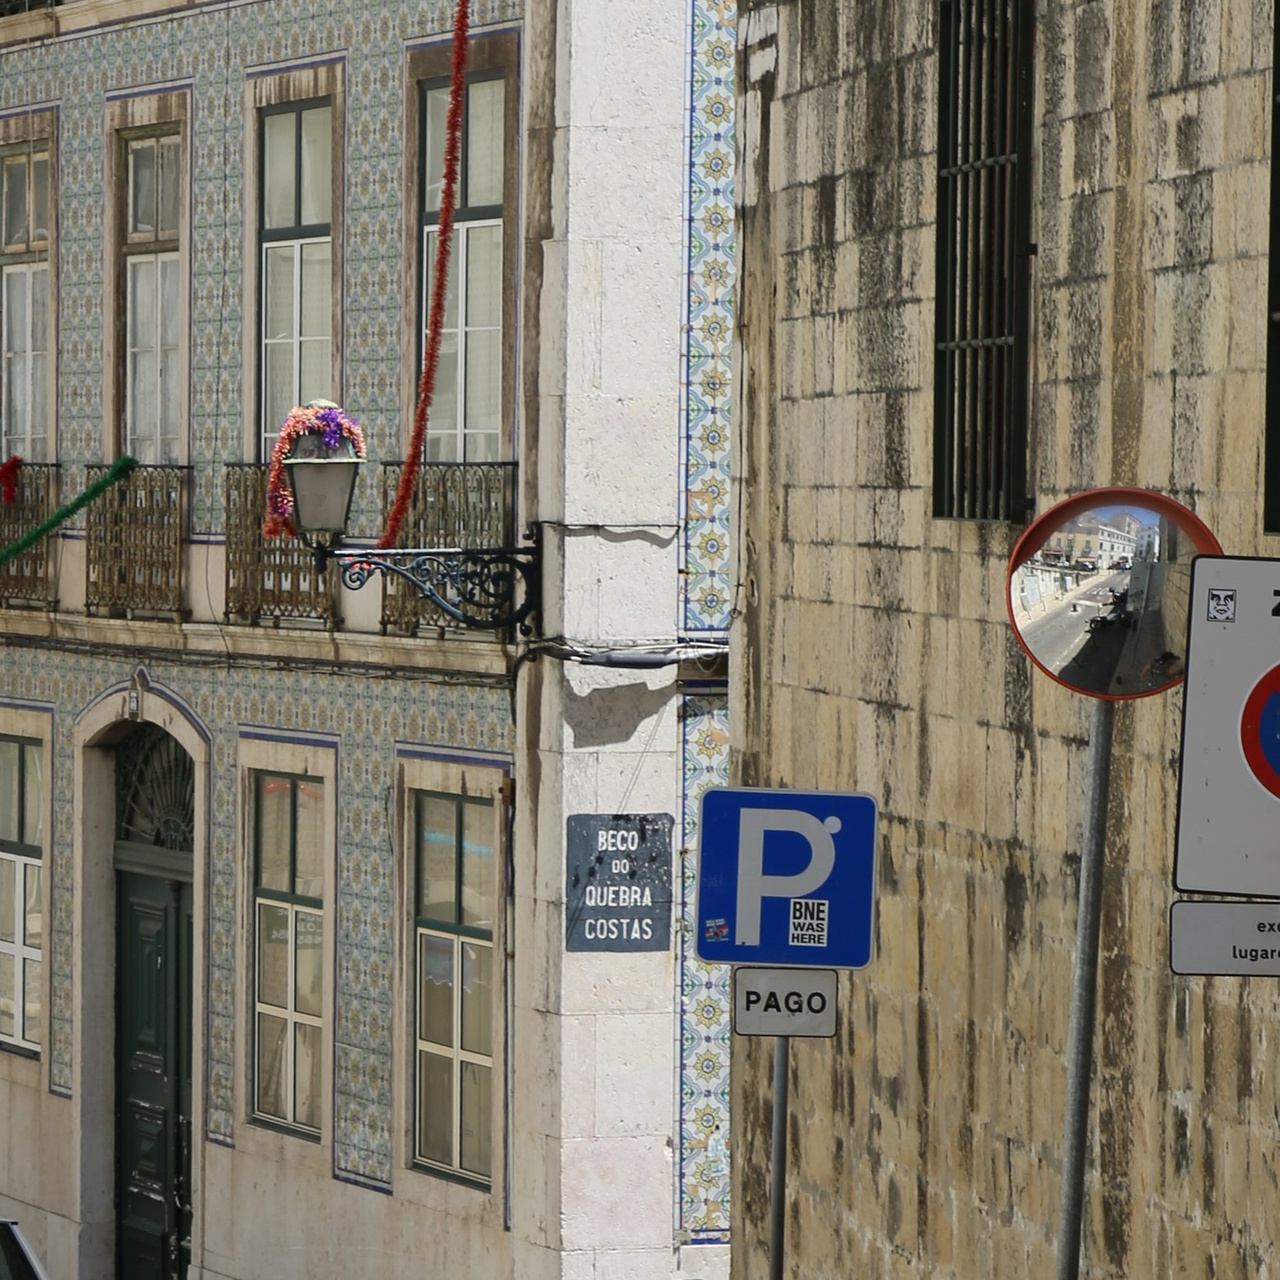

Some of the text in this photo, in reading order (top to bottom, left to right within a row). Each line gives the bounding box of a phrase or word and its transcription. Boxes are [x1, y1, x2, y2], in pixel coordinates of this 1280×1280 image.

[598, 830, 639, 852] BECO
[611, 859, 630, 874] DO
[585, 885, 653, 908] QUEBRA
[792, 901, 826, 921] BNE
[584, 918, 653, 940] COSTAS
[792, 922, 825, 933] WAS
[791, 933, 825, 945] HERE
[1232, 945, 1280, 962] lugar
[745, 990, 827, 1014] PAGO
